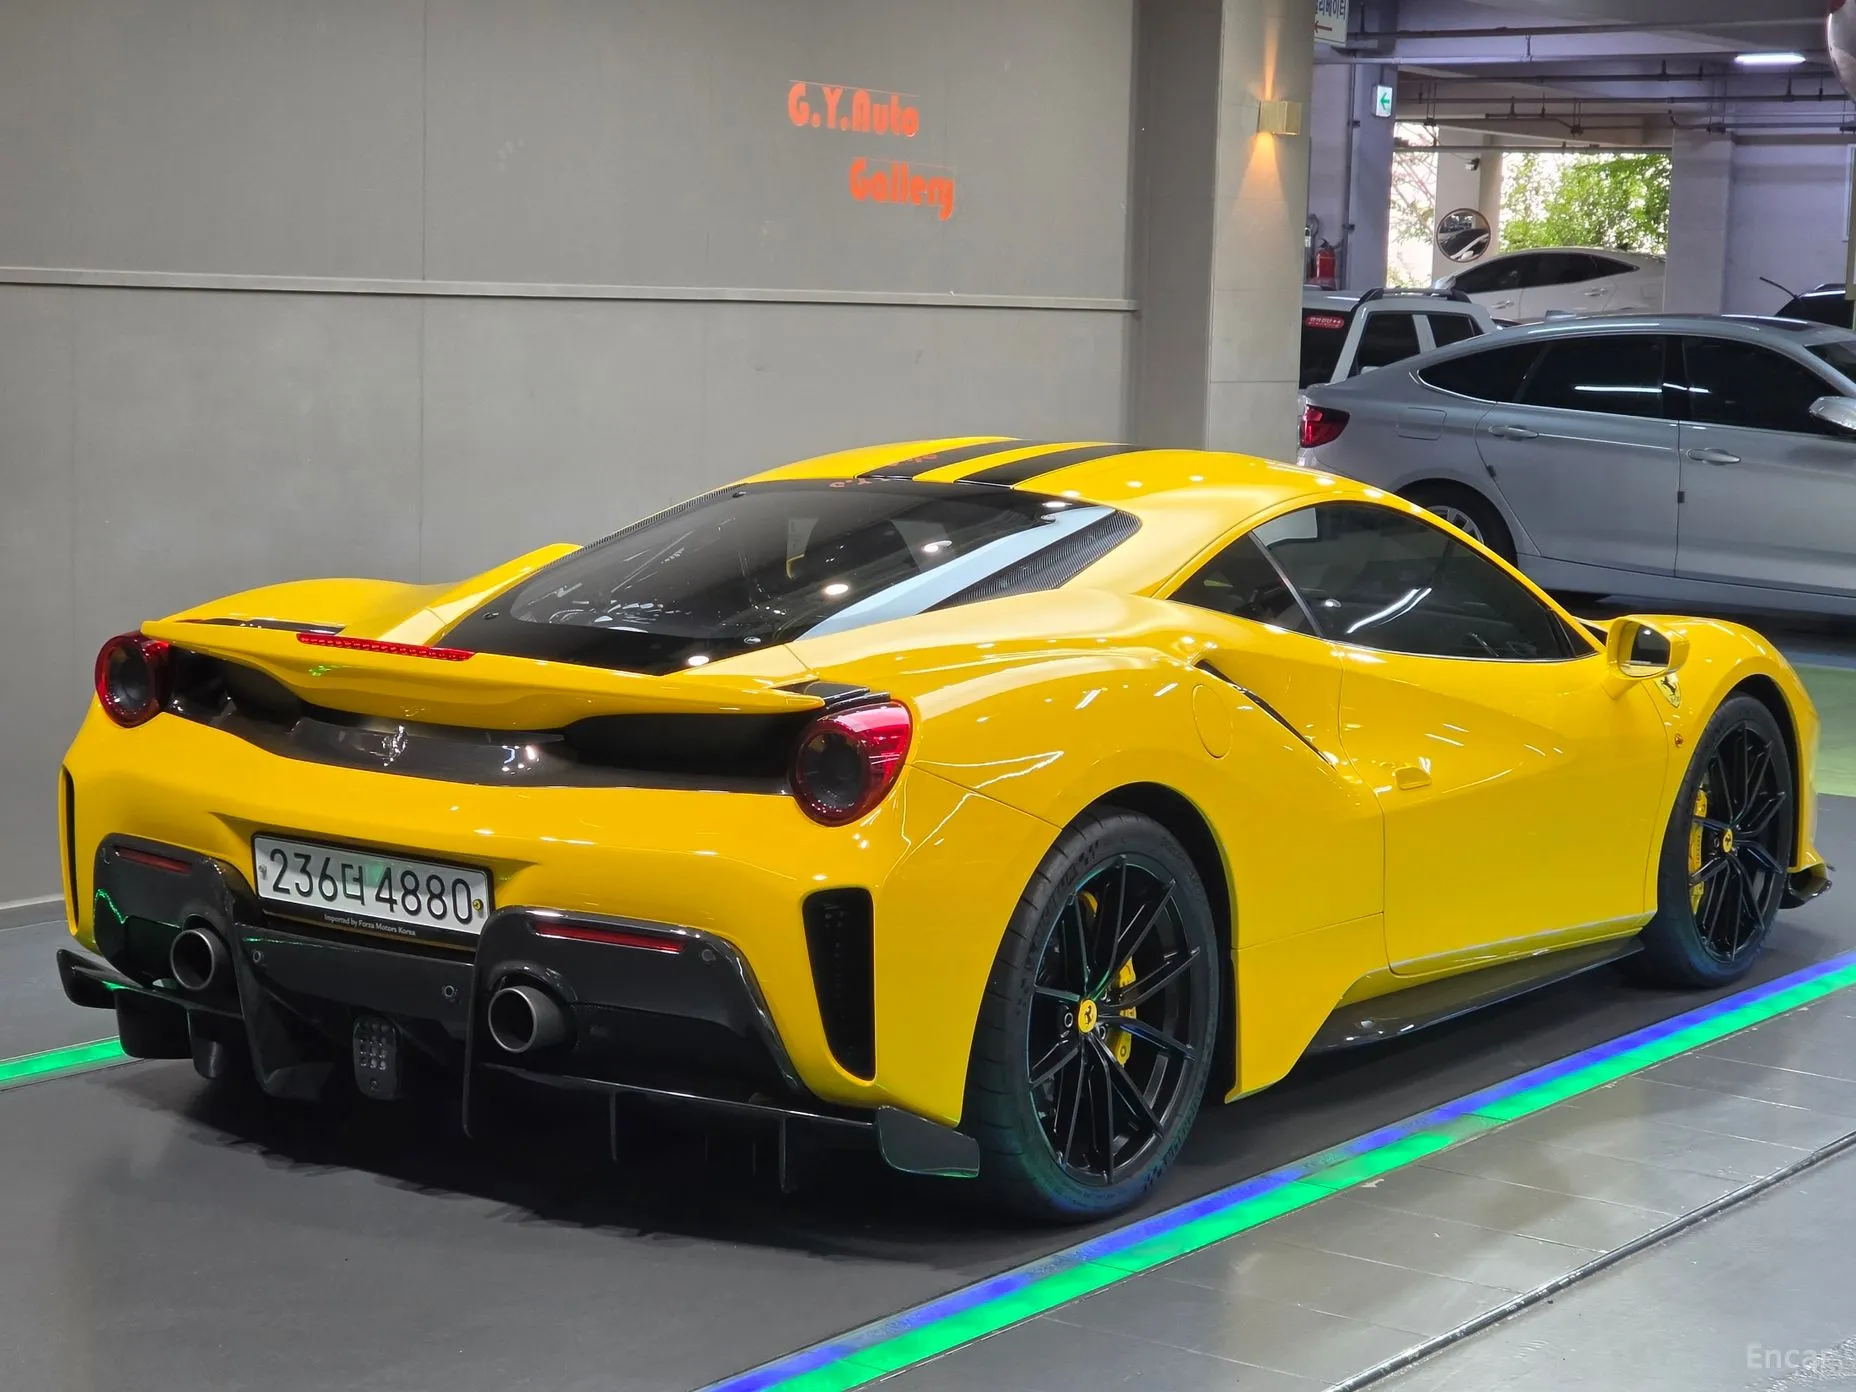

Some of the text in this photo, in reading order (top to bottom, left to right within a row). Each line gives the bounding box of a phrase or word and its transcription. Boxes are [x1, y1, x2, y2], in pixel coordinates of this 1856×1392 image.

[788, 82, 919, 137] G.Y.Auto
[849, 157, 954, 221] Gallery
[324, 913, 350, 924] Imported
[375, 922, 397, 933] Motors
[398, 926, 416, 936] Korea
